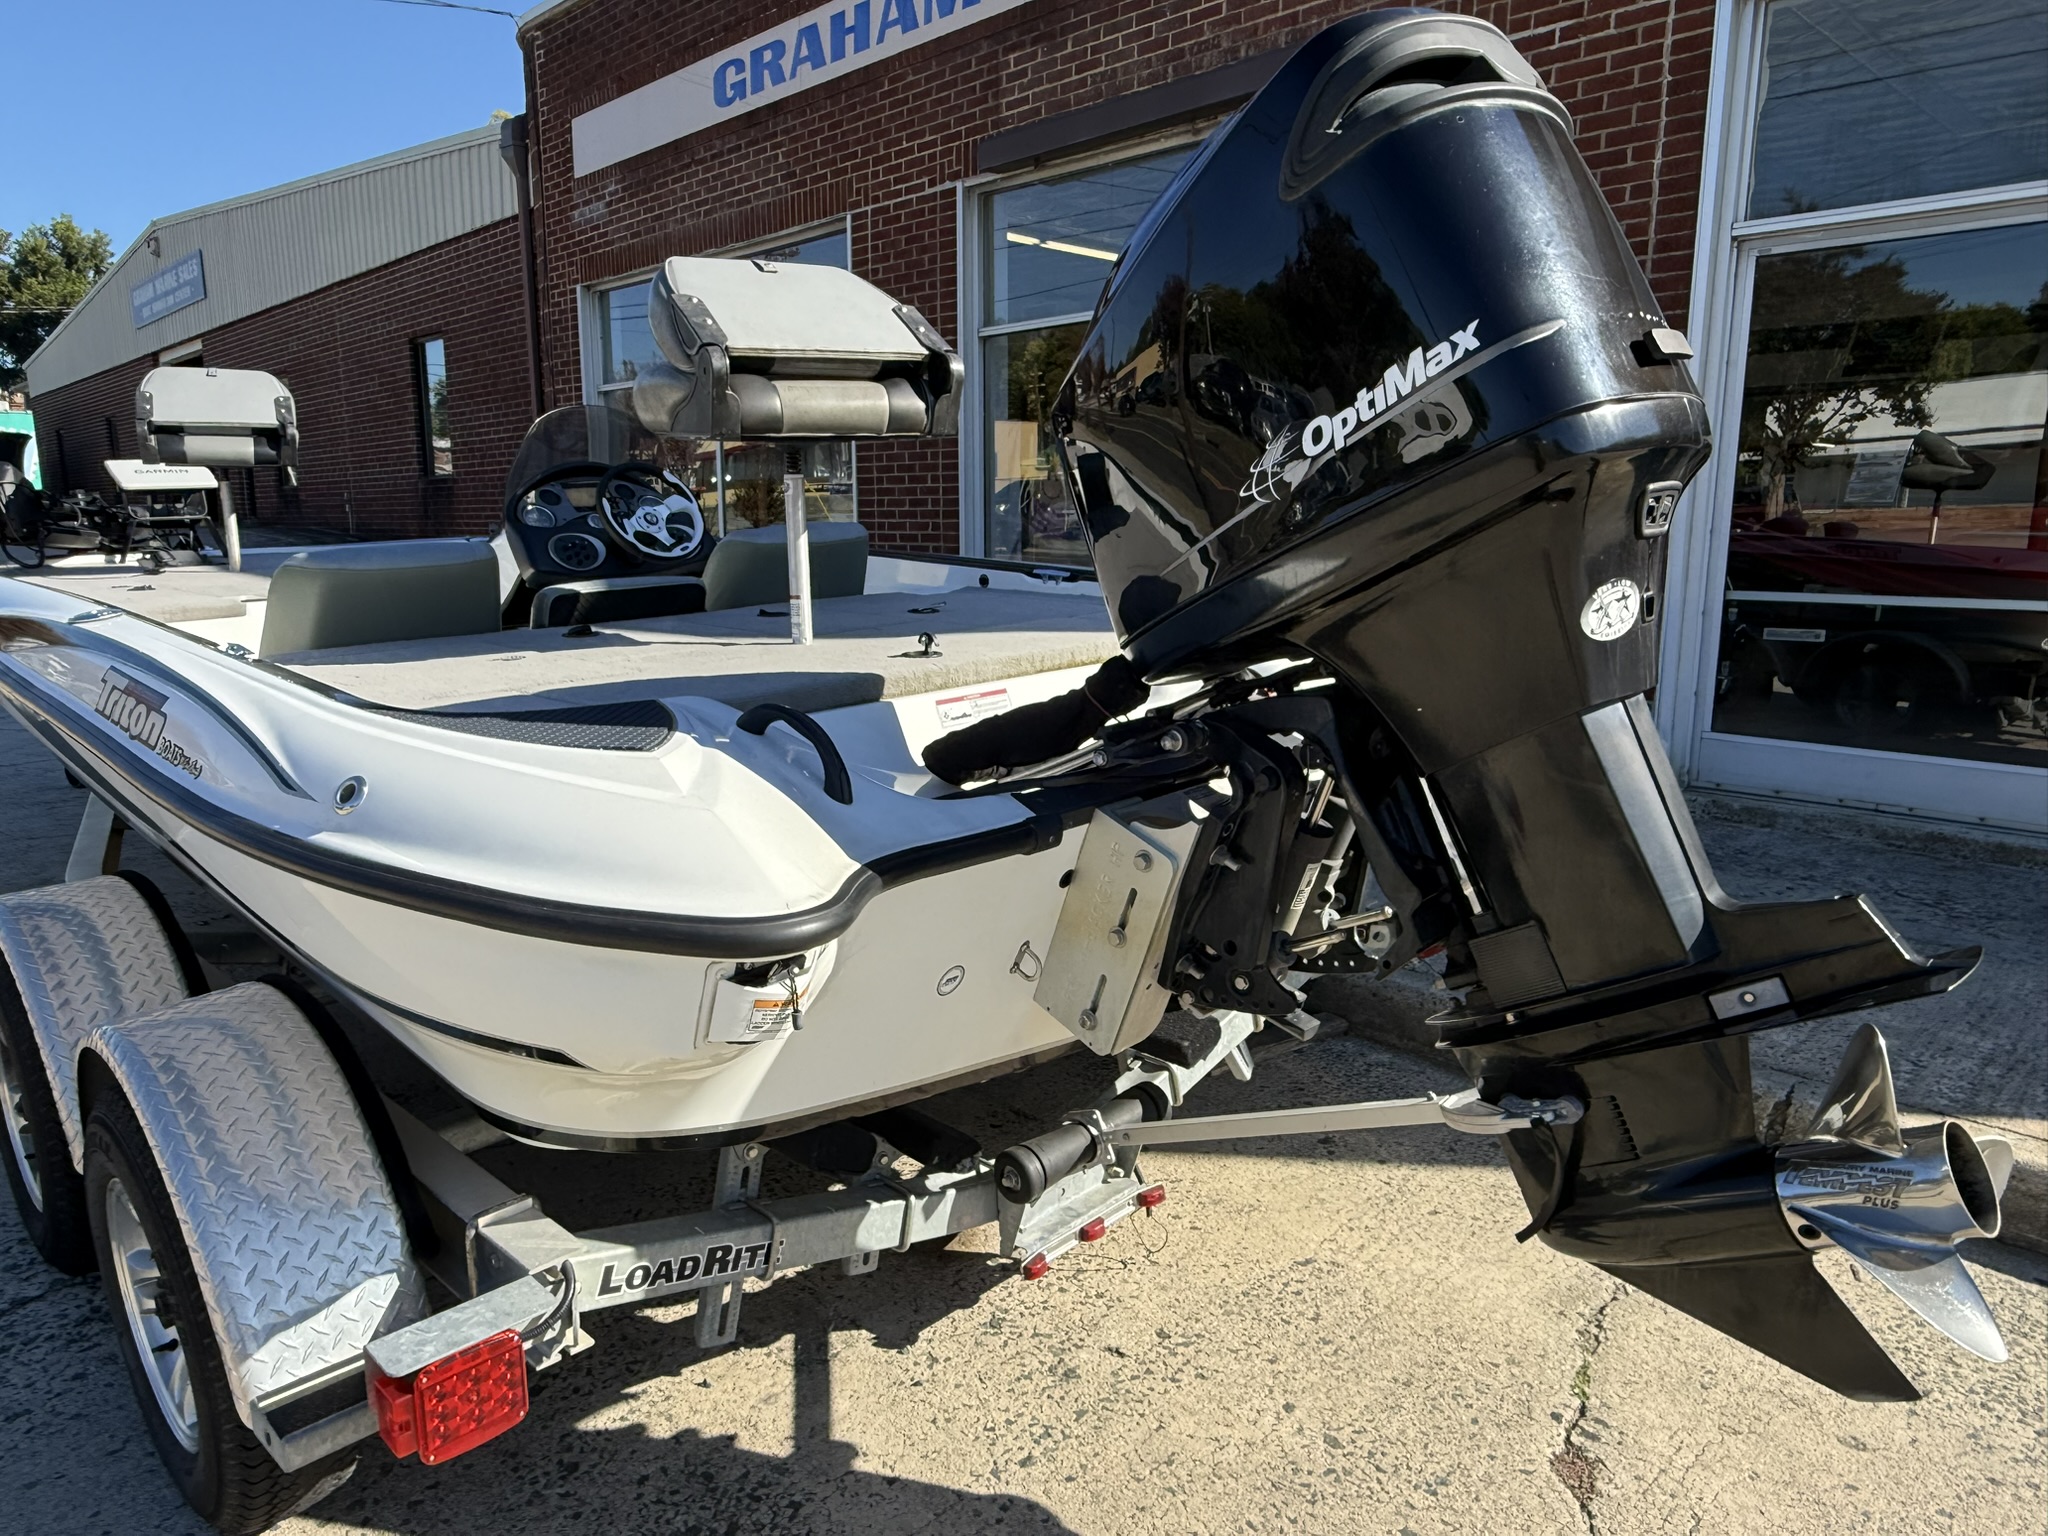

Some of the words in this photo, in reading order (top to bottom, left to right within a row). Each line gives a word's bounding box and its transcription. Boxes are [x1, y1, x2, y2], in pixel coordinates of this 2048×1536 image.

[1301, 318, 1481, 457] OptiMax
[94, 665, 168, 751] Triton
[1783, 1160, 1913, 1198] TEMPEST
[1862, 1195, 1900, 1210] PLUS
